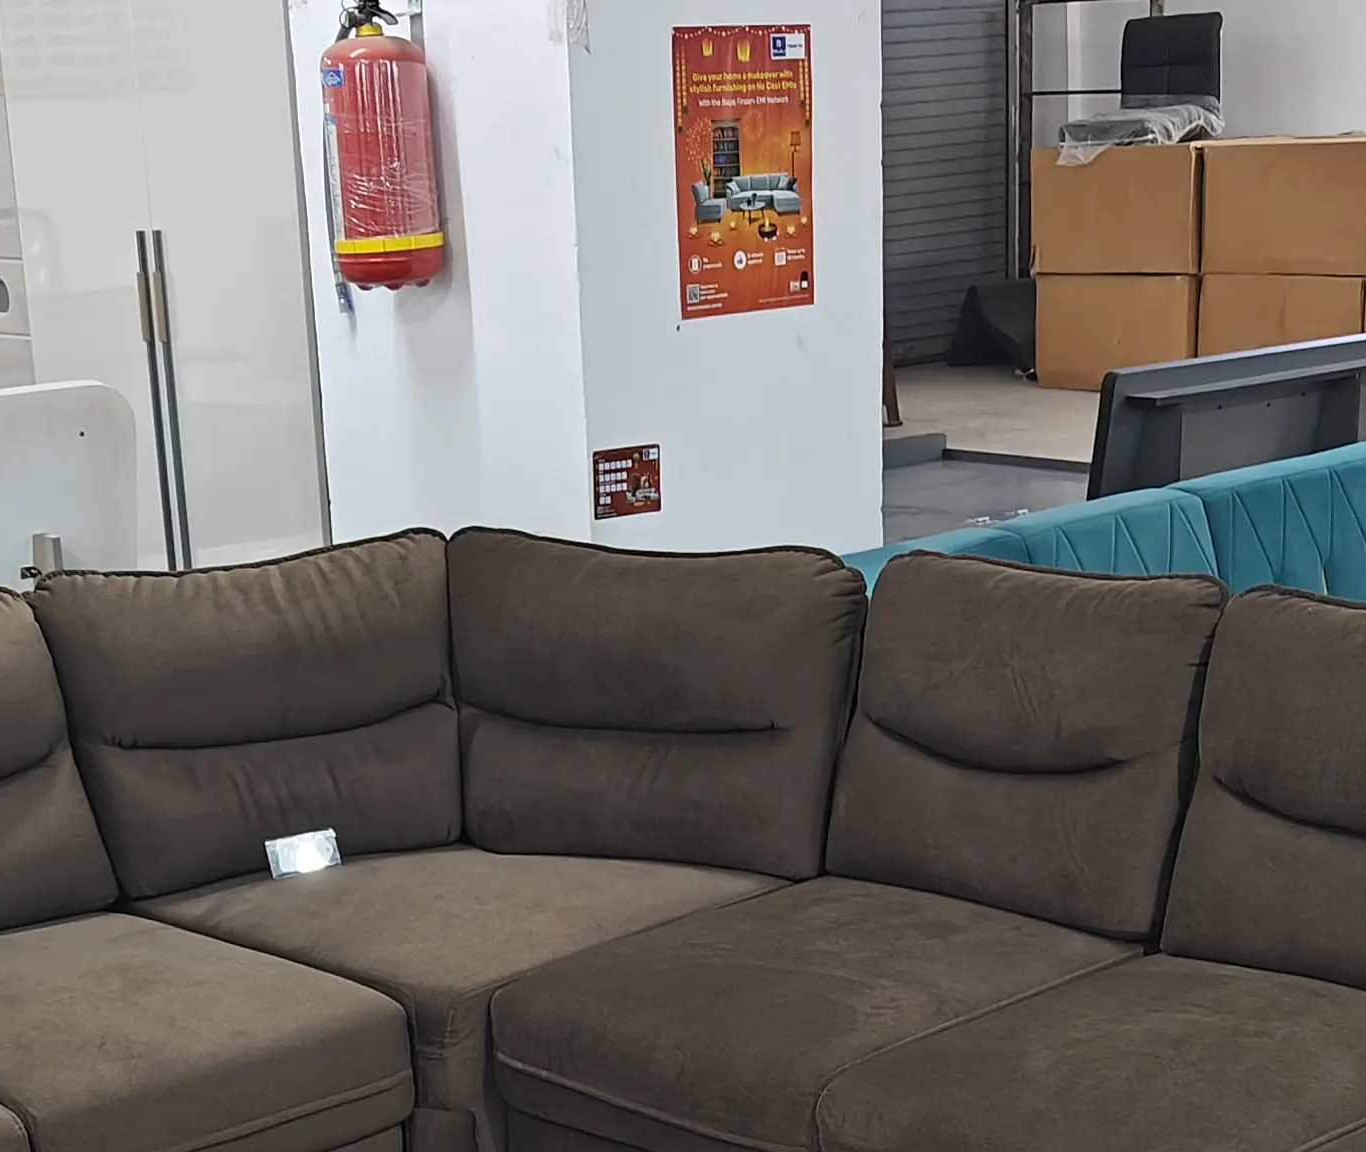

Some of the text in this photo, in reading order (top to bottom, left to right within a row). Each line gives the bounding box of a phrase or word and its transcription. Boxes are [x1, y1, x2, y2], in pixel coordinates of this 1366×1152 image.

[692, 73, 707, 81] Give
[707, 73, 722, 83] your
[723, 71, 741, 80] home
[747, 70, 779, 80] makeover
[779, 69, 793, 78] with
[689, 83, 712, 94] stylish
[713, 82, 747, 93] furnishing
[766, 81, 780, 90] Cost
